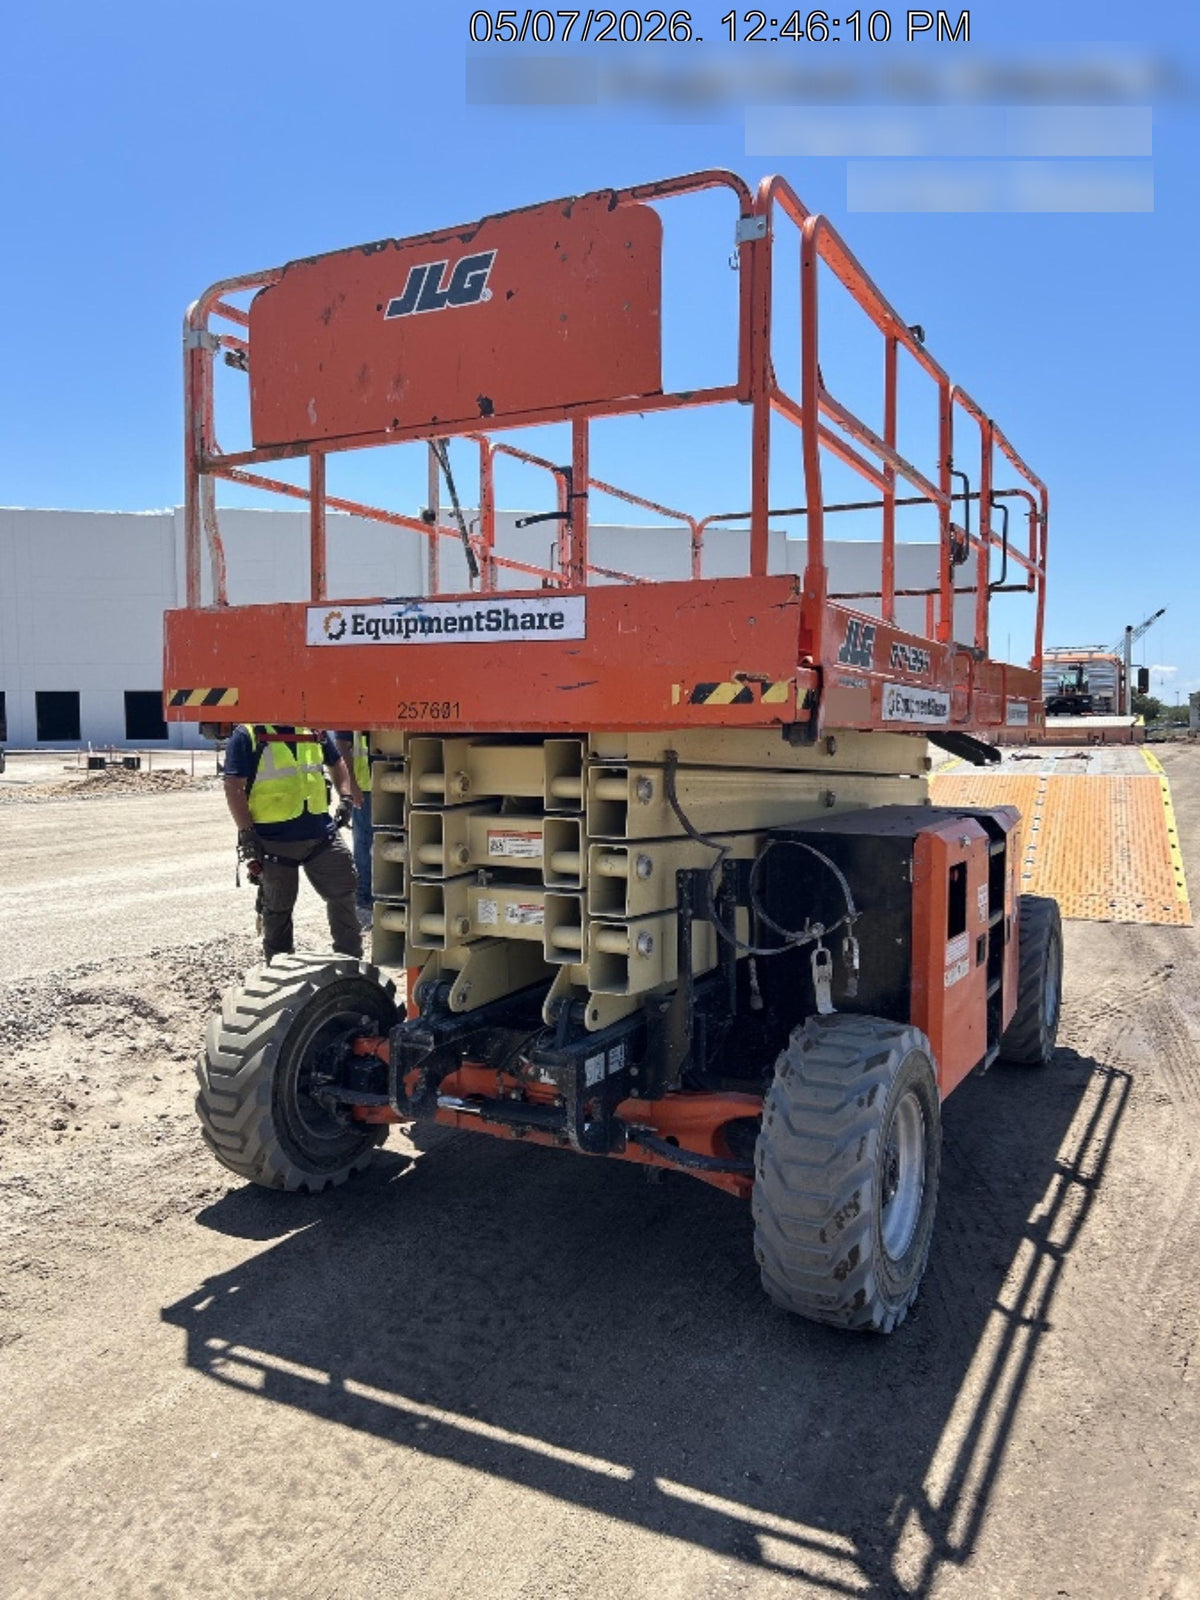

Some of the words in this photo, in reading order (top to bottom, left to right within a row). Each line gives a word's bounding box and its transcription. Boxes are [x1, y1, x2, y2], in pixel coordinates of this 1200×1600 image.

[384, 249, 498, 320] JLG
[351, 608, 565, 641] EquipmentShare
[838, 617, 877, 670] JLG
